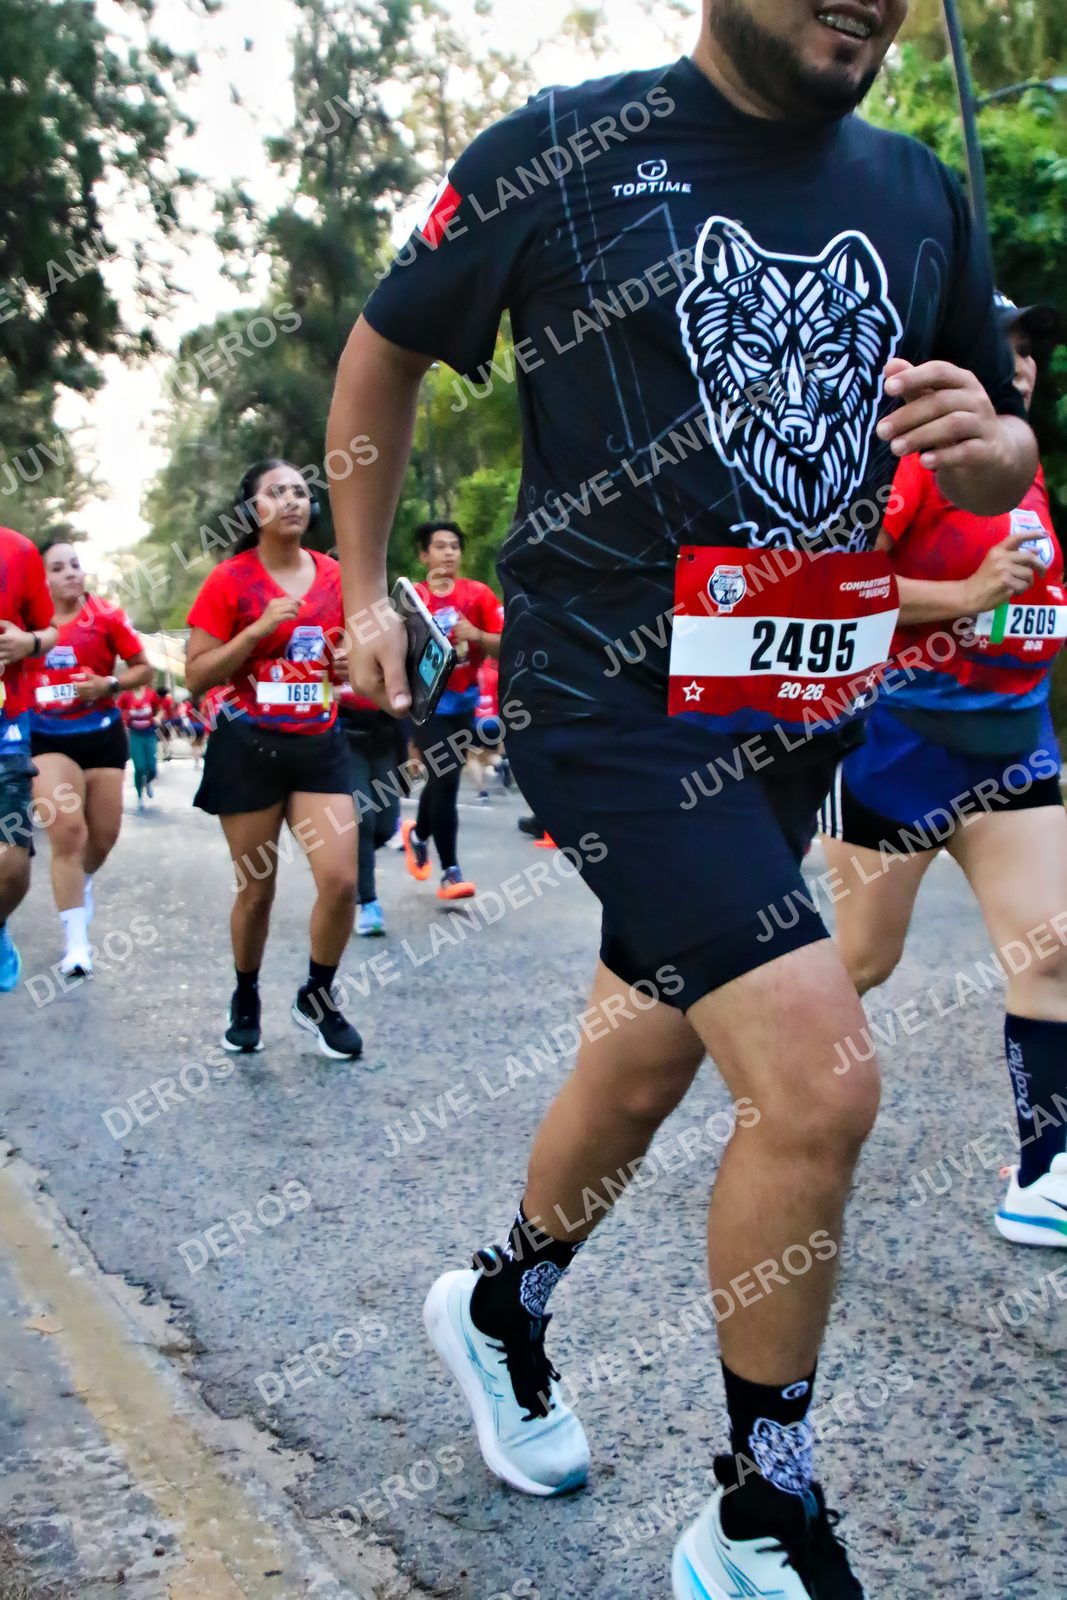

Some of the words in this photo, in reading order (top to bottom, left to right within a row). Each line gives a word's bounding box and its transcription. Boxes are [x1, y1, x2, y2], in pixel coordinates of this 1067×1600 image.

[612, 181, 692, 197] TOPTIME
[1010, 606, 1057, 635] 2609
[750, 620, 858, 673] 2495
[287, 684, 318, 702] 1692
